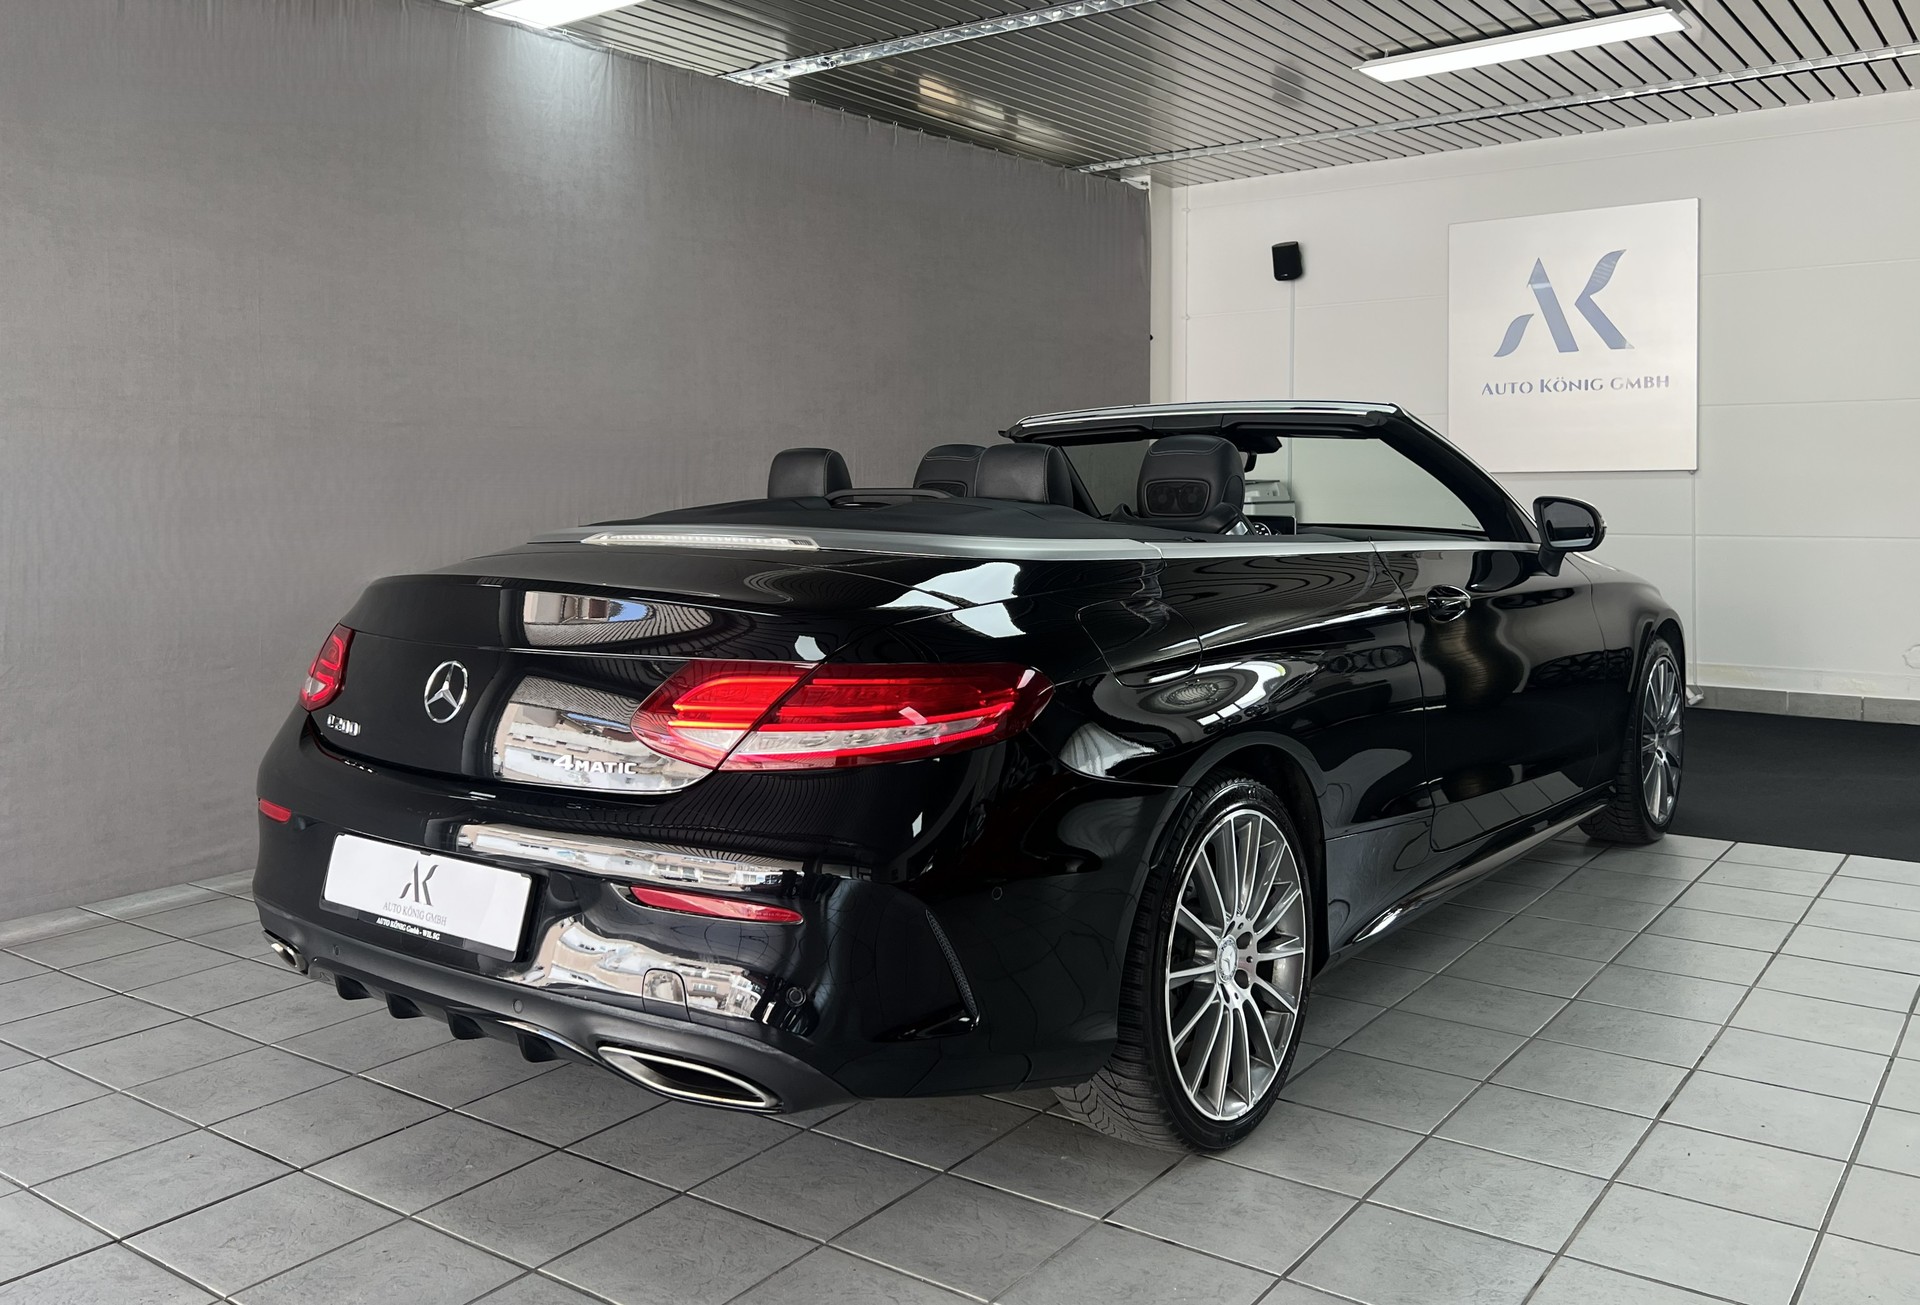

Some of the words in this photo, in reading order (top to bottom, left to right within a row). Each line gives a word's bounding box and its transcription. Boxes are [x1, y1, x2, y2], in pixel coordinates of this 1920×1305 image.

[1494, 249, 1635, 357] AK
[1481, 381, 1533, 396] AUTO
[1539, 376, 1603, 393] KÖNIG
[1610, 375, 1669, 390] GMBH
[554, 755, 637, 775] 4MATIC
[399, 861, 439, 907] AK
[376, 917, 390, 926] AUTO
[383, 902, 401, 914] AUTO
[403, 905, 425, 920] KÖNIG
[426, 912, 448, 926] GMBH
